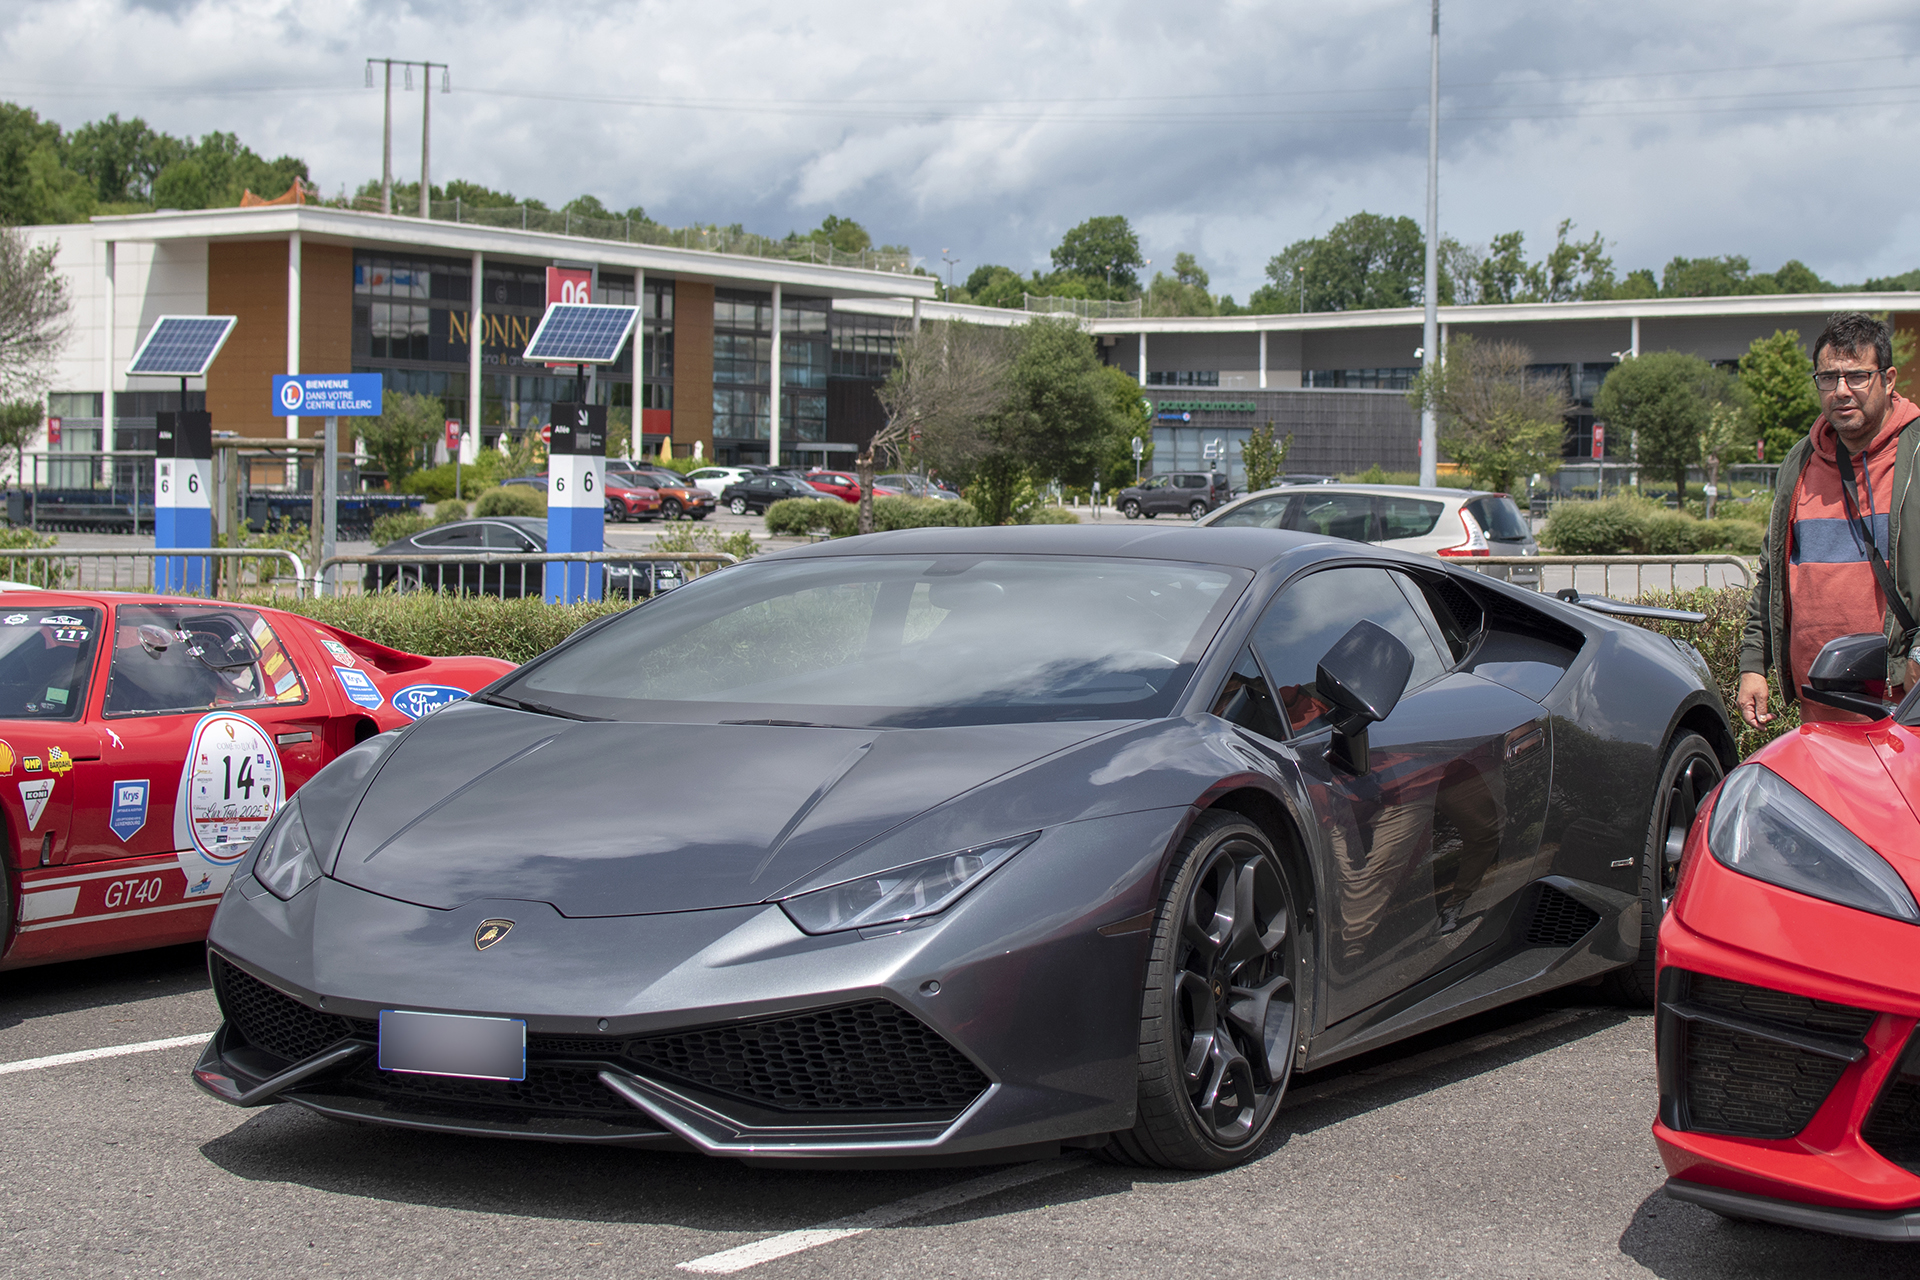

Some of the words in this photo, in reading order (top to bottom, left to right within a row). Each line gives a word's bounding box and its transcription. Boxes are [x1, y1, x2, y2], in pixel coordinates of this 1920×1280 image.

[561, 280, 588, 304] 06
[448, 310, 541, 348] NONN
[305, 379, 349, 390] BIENVENUE
[305, 391, 327, 401] DANS
[328, 391, 353, 401] VOTRE
[305, 400, 336, 410] CENTRE
[337, 400, 372, 410] LECLERC
[1158, 400, 1256, 414] parapharmacie
[554, 425, 571, 434] Allée
[161, 480, 169, 493] 6
[188, 473, 199, 494] 6
[556, 477, 565, 492] 6
[584, 471, 593, 492] 6
[345, 674, 363, 684] Krys
[25, 759, 41, 769] OMP
[49, 760, 72, 769] BARDAHL
[223, 755, 255, 800] 14
[26, 791, 47, 799] KONI
[122, 790, 140, 802] Krys
[202, 802, 220, 822] Lux
[223, 803, 238, 819] Tour
[239, 804, 263, 818] 2025
[105, 877, 162, 908] GT40
